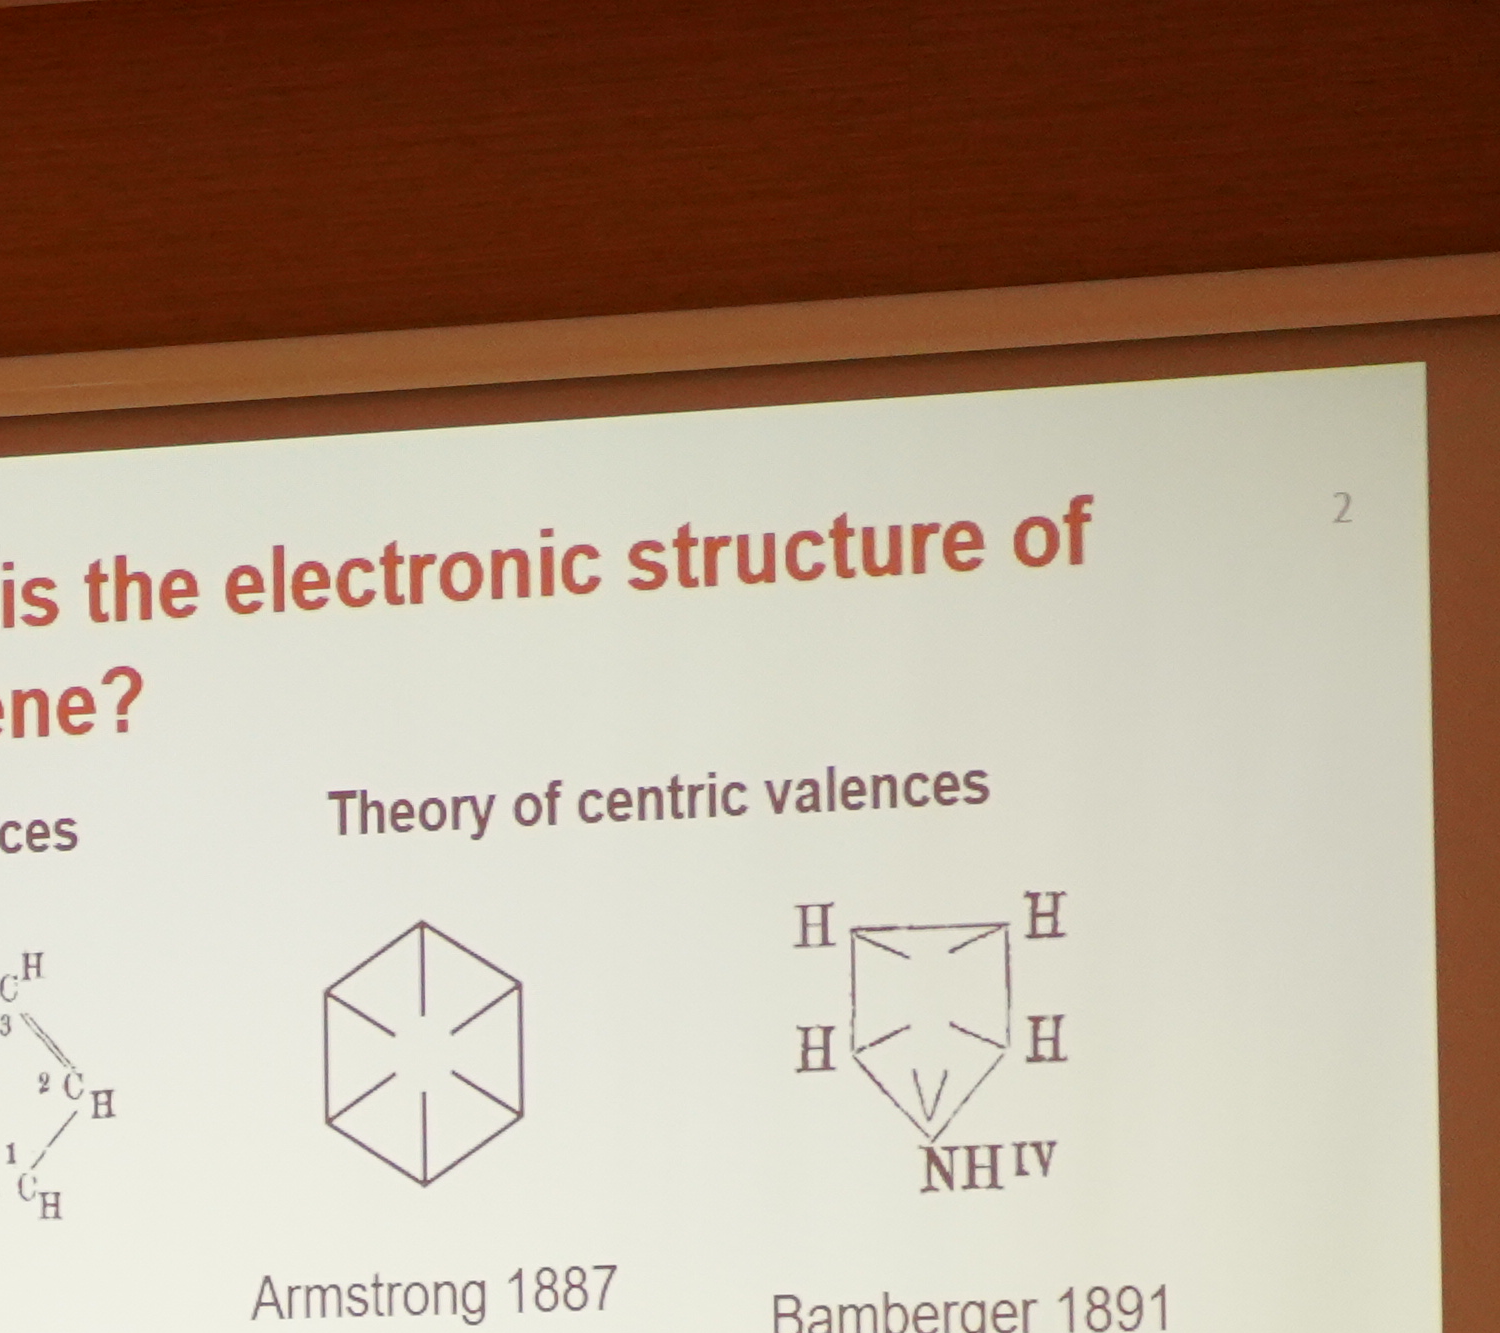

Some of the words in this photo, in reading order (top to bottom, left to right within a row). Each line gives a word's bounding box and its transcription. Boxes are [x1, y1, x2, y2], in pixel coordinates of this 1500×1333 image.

[1332, 491, 1353, 524] 2
[1, 561, 60, 629] is
[83, 554, 200, 624] the
[224, 527, 602, 615] electronic
[627, 511, 986, 591] structure
[1013, 493, 1095, 568] of
[327, 789, 497, 841] Theory
[513, 779, 563, 827] of
[577, 771, 749, 824] centric
[763, 765, 991, 815] valences
[793, 901, 837, 949] H
[1023, 890, 1068, 940] H
[794, 1024, 837, 1074] H
[1025, 1013, 1069, 1064] H
[250, 1272, 486, 1326] Armstrong
[508, 1264, 618, 1314] 1887
[1058, 1283, 1167, 1333] 1891
